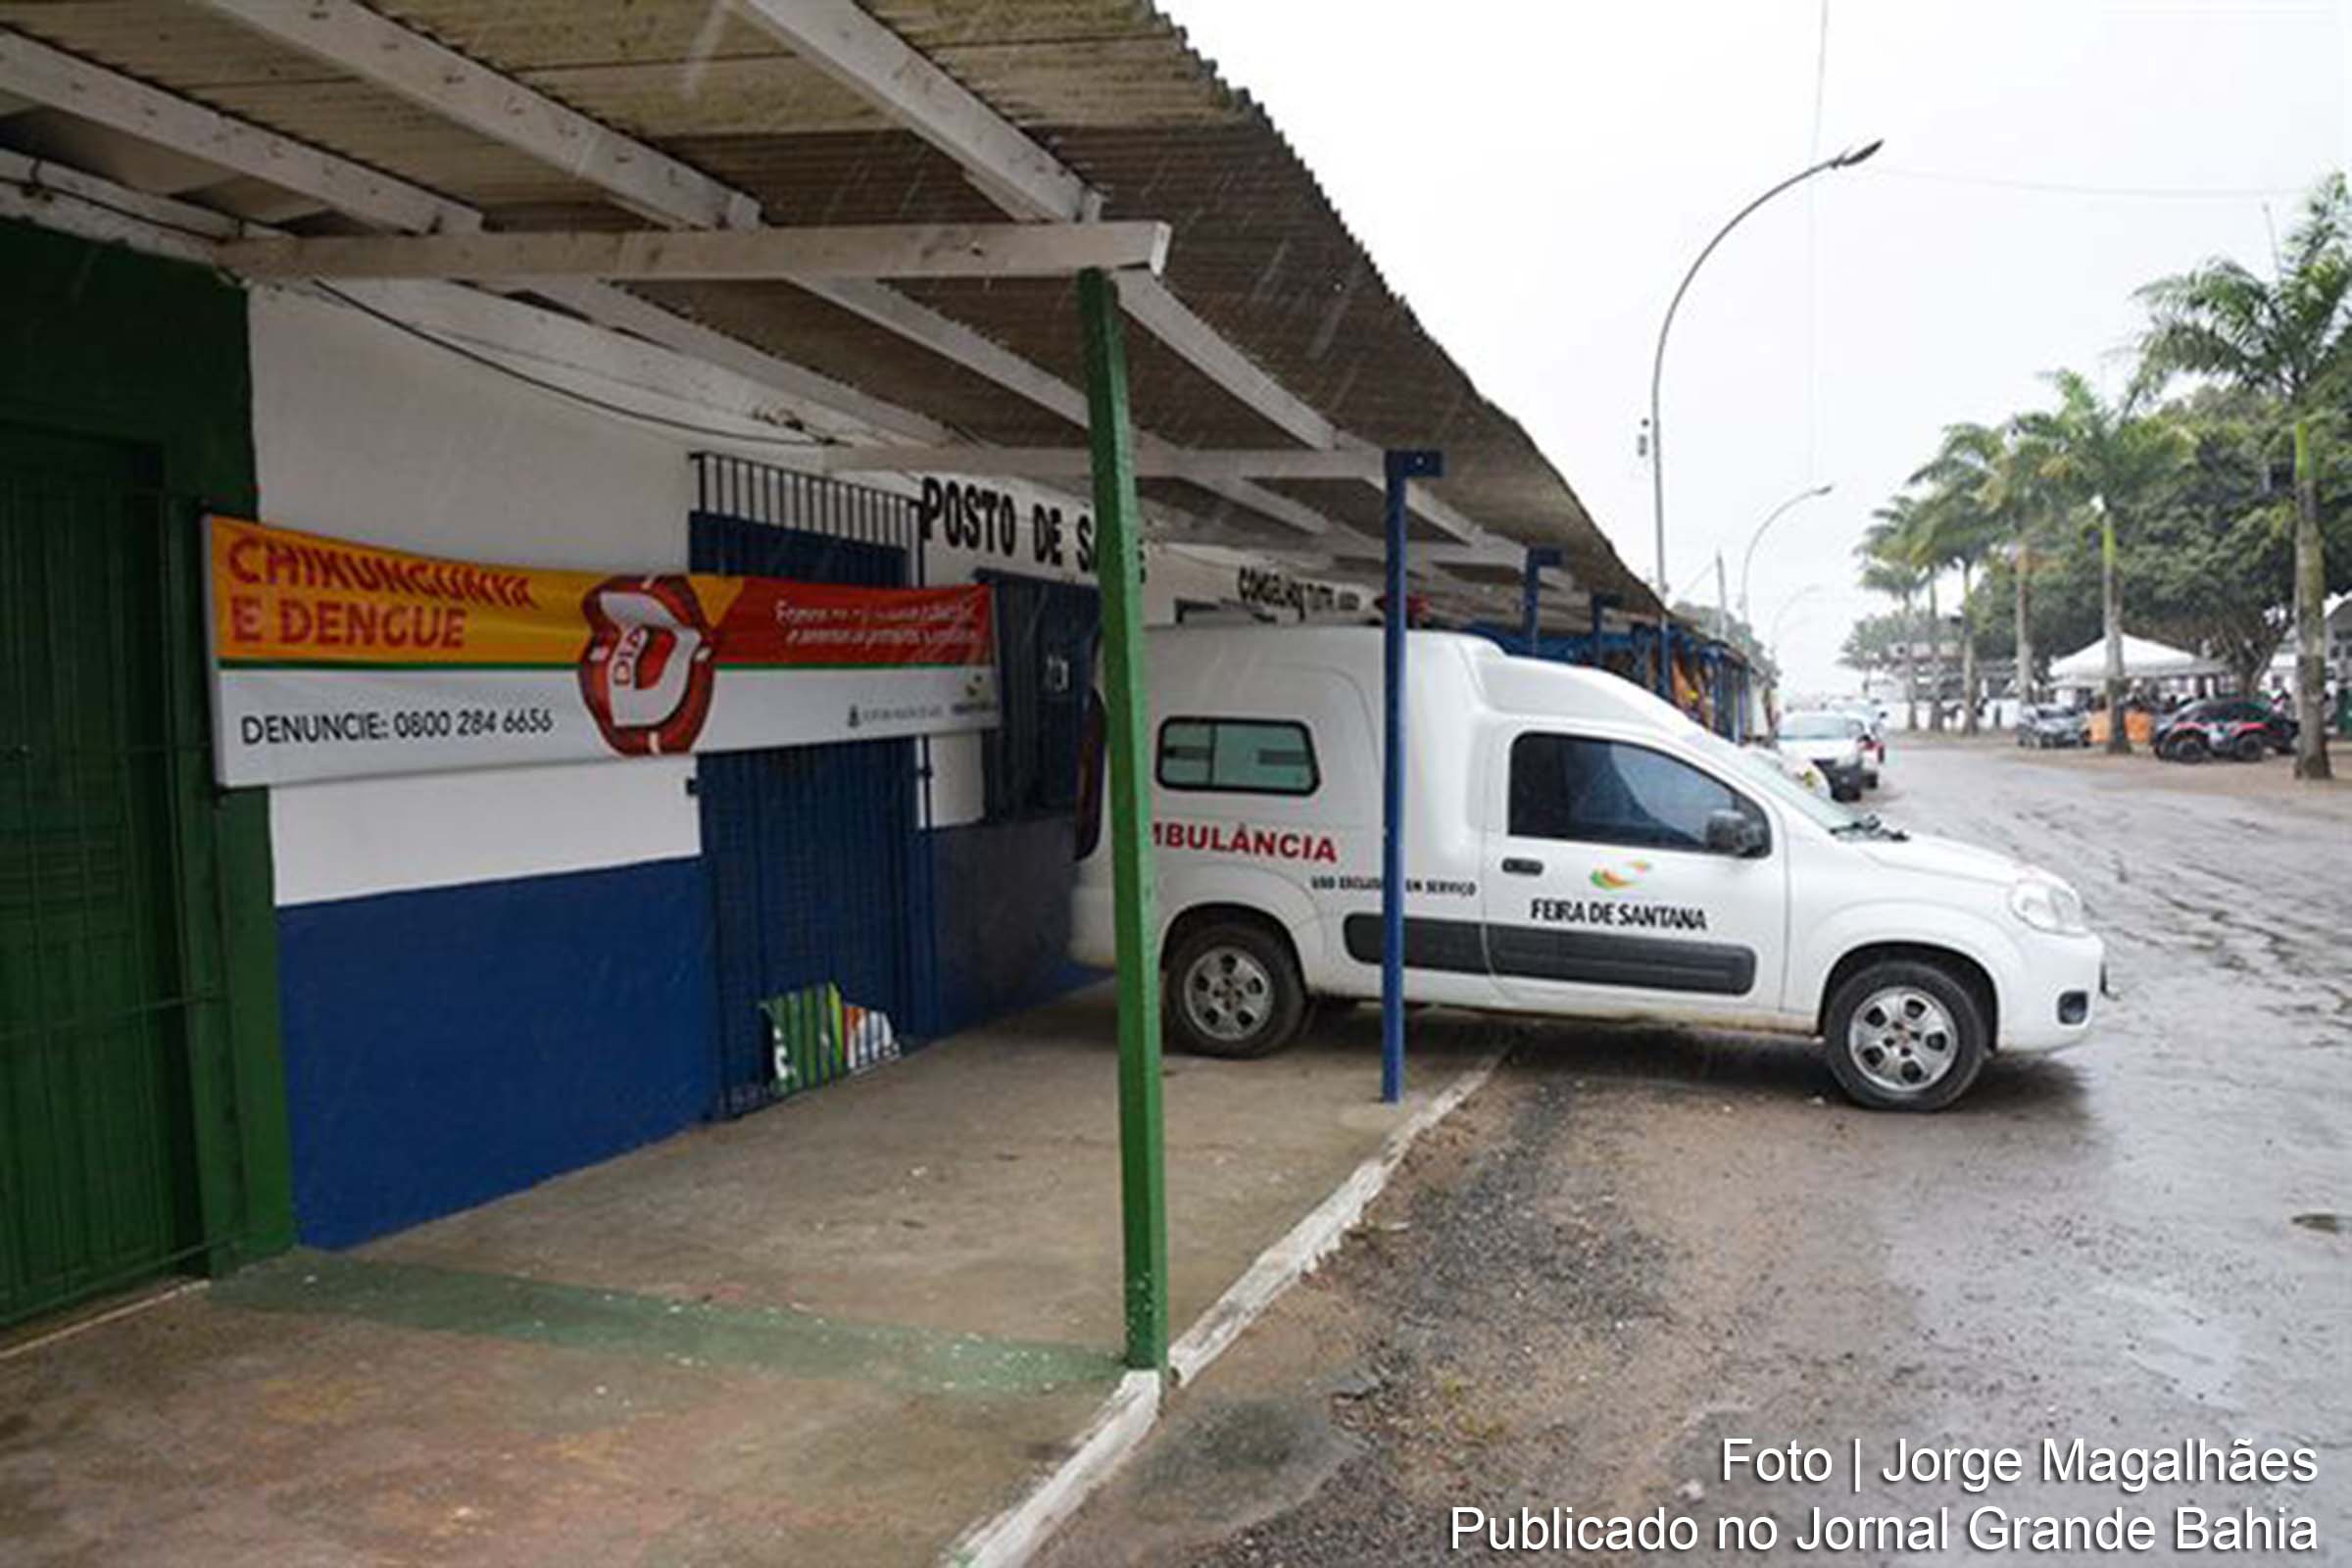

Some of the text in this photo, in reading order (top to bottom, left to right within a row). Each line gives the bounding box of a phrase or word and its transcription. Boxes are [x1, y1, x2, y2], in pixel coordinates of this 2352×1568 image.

[922, 476, 1016, 557] POSTO
[1033, 504, 1062, 565] DE
[230, 596, 467, 648] E DENGUE
[241, 708, 554, 745] DENUNCIE: 0800 284 6656
[1152, 822, 1338, 862] BULÂNCIA
[1531, 899, 1707, 930] FEIRA DE SANTANA
